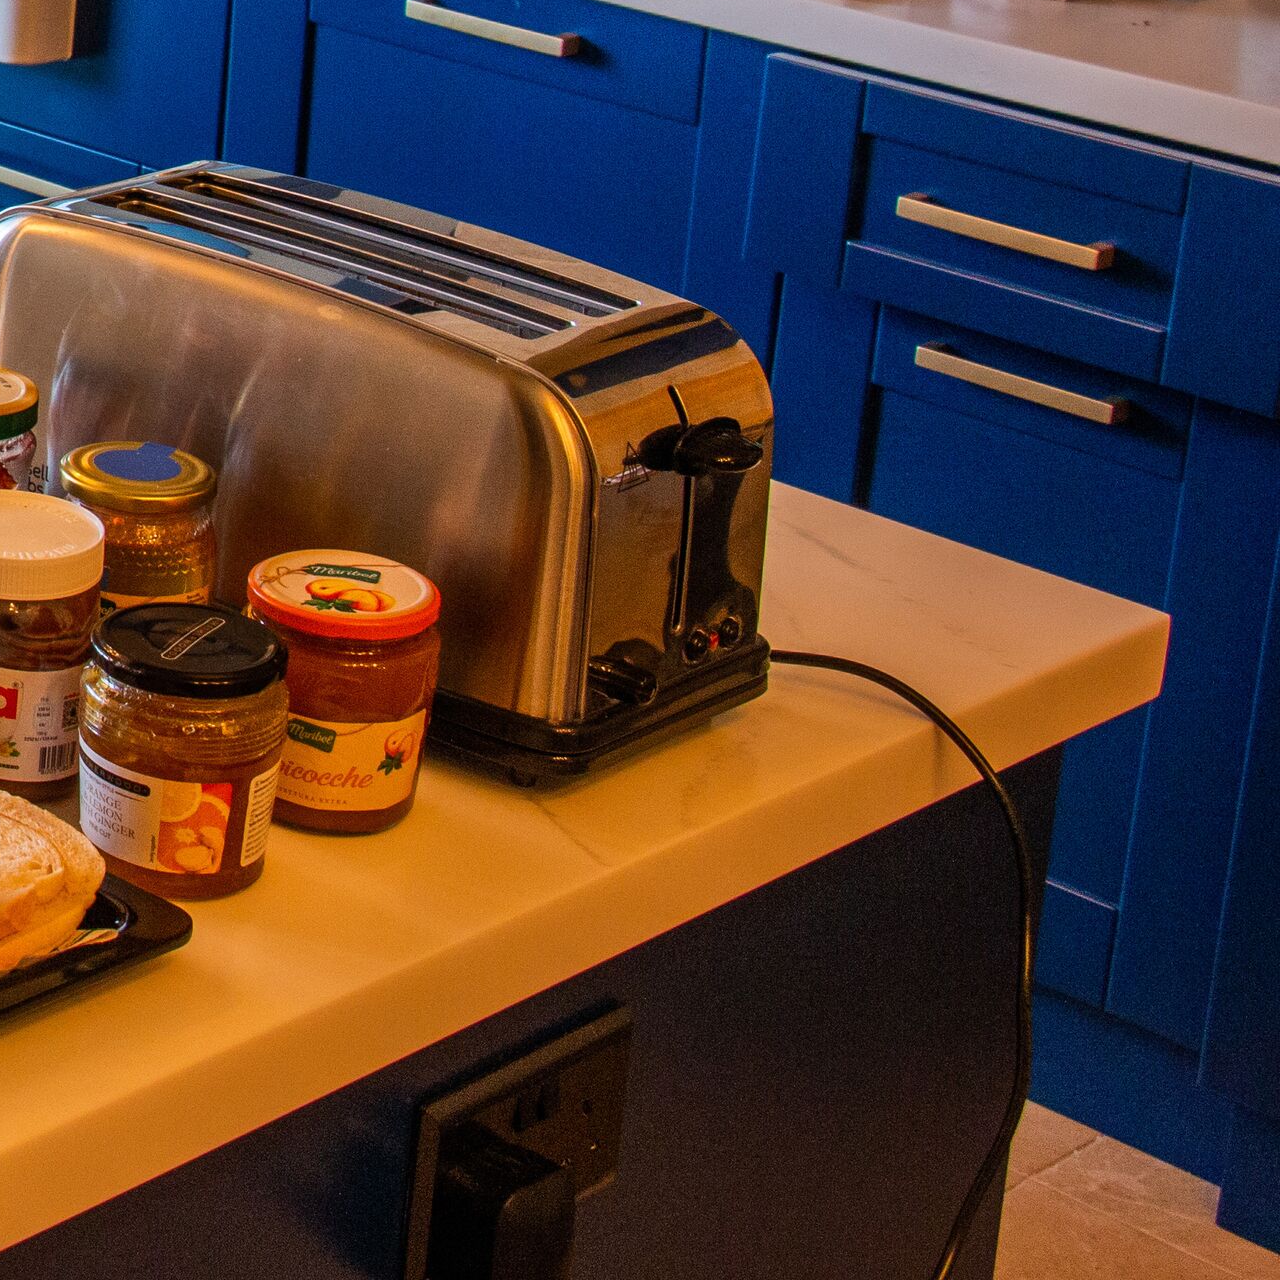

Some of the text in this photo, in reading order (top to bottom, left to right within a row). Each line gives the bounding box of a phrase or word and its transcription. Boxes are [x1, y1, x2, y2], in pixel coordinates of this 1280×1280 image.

[311, 565, 379, 579] Maribel
[289, 722, 335, 746] Maribel
[280, 760, 374, 789] icocche
[93, 811, 137, 840] GINGER
